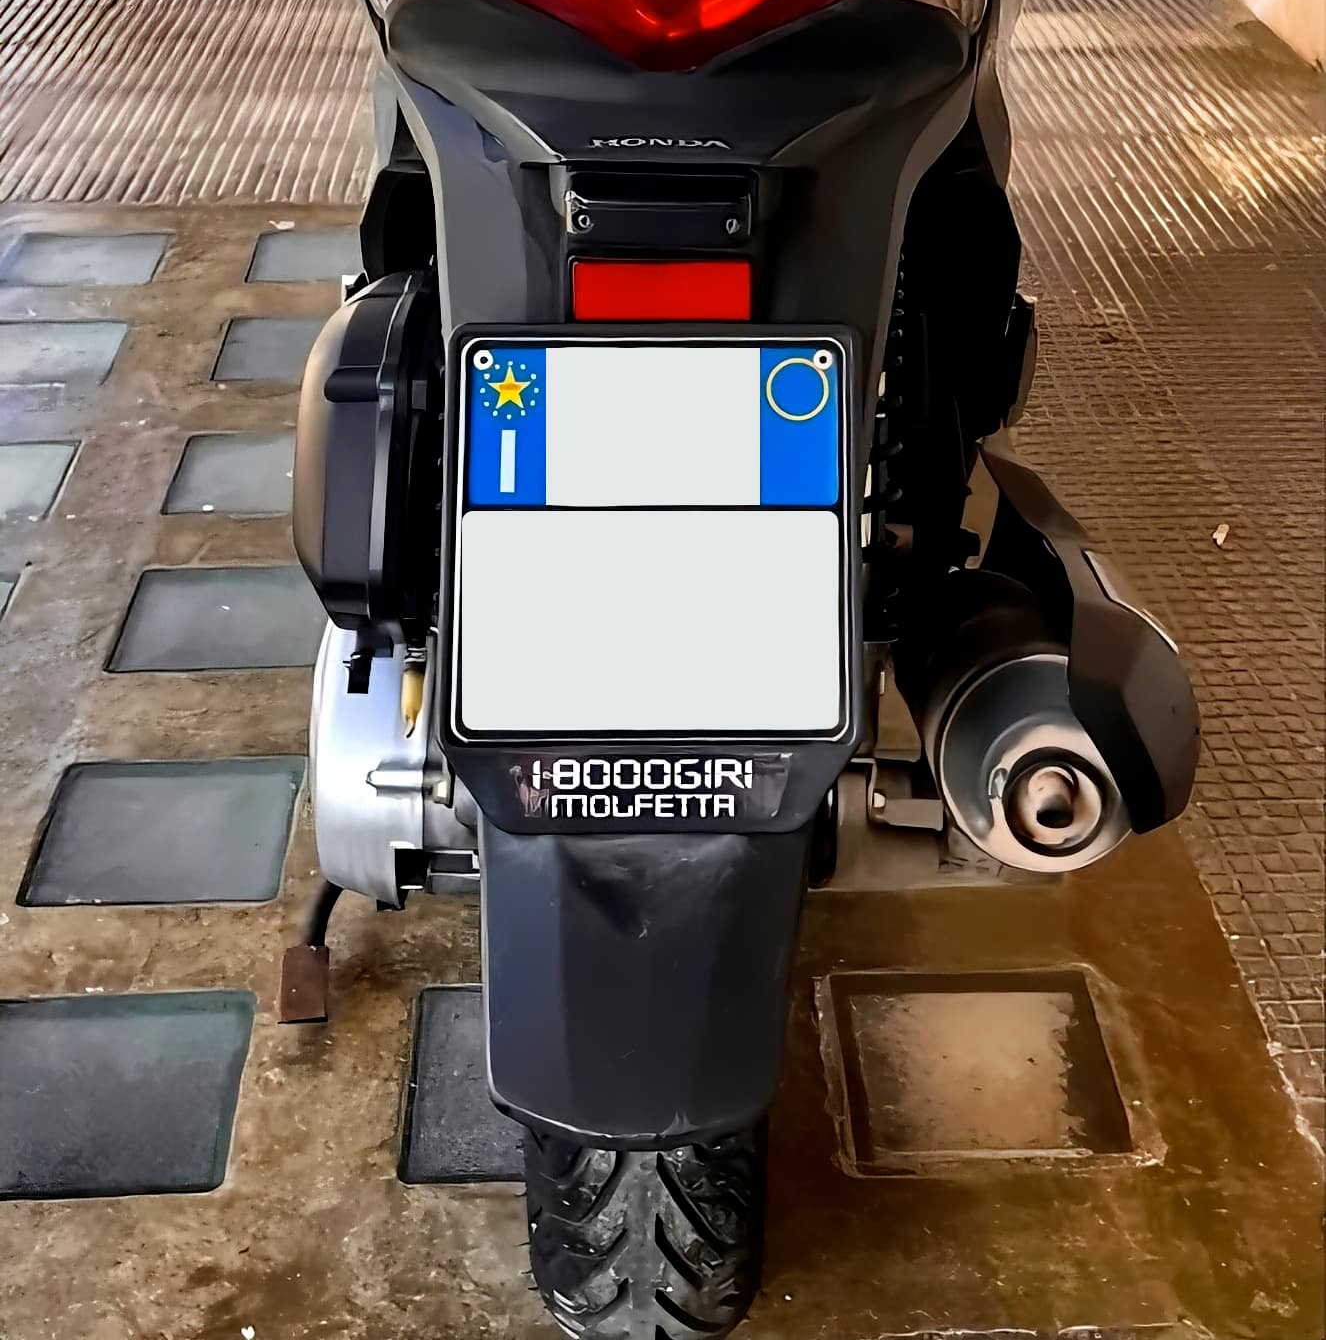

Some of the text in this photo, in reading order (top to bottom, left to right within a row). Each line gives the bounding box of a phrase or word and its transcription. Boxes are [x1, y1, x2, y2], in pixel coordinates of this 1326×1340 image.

[585, 137, 731, 150] HONDA
[499, 429, 516, 493] I
[551, 793, 736, 818] MOLFETTA
